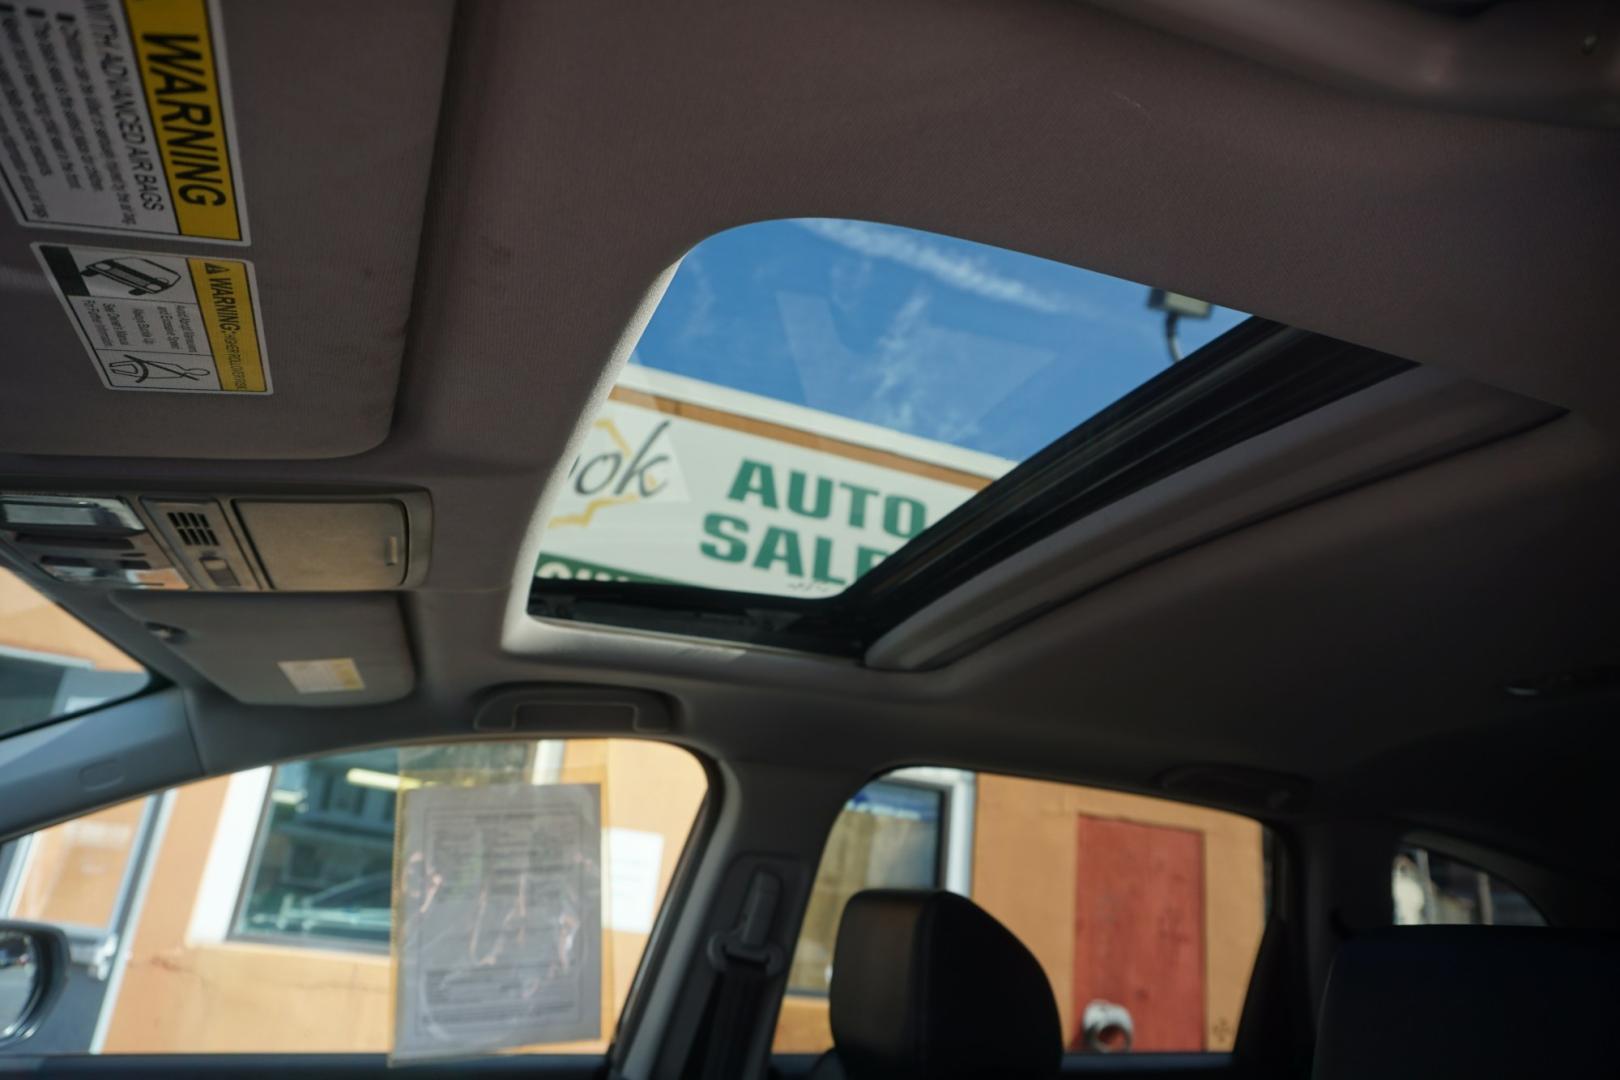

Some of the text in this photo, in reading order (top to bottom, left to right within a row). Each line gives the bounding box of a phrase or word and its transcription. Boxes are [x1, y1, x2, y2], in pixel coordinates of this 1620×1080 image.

[142, 32, 226, 206] WARNING
[127, 146, 153, 171] AIR
[134, 174, 164, 211] BAGS
[210, 278, 240, 334] WARNING:
[727, 458, 927, 539] AUTO
